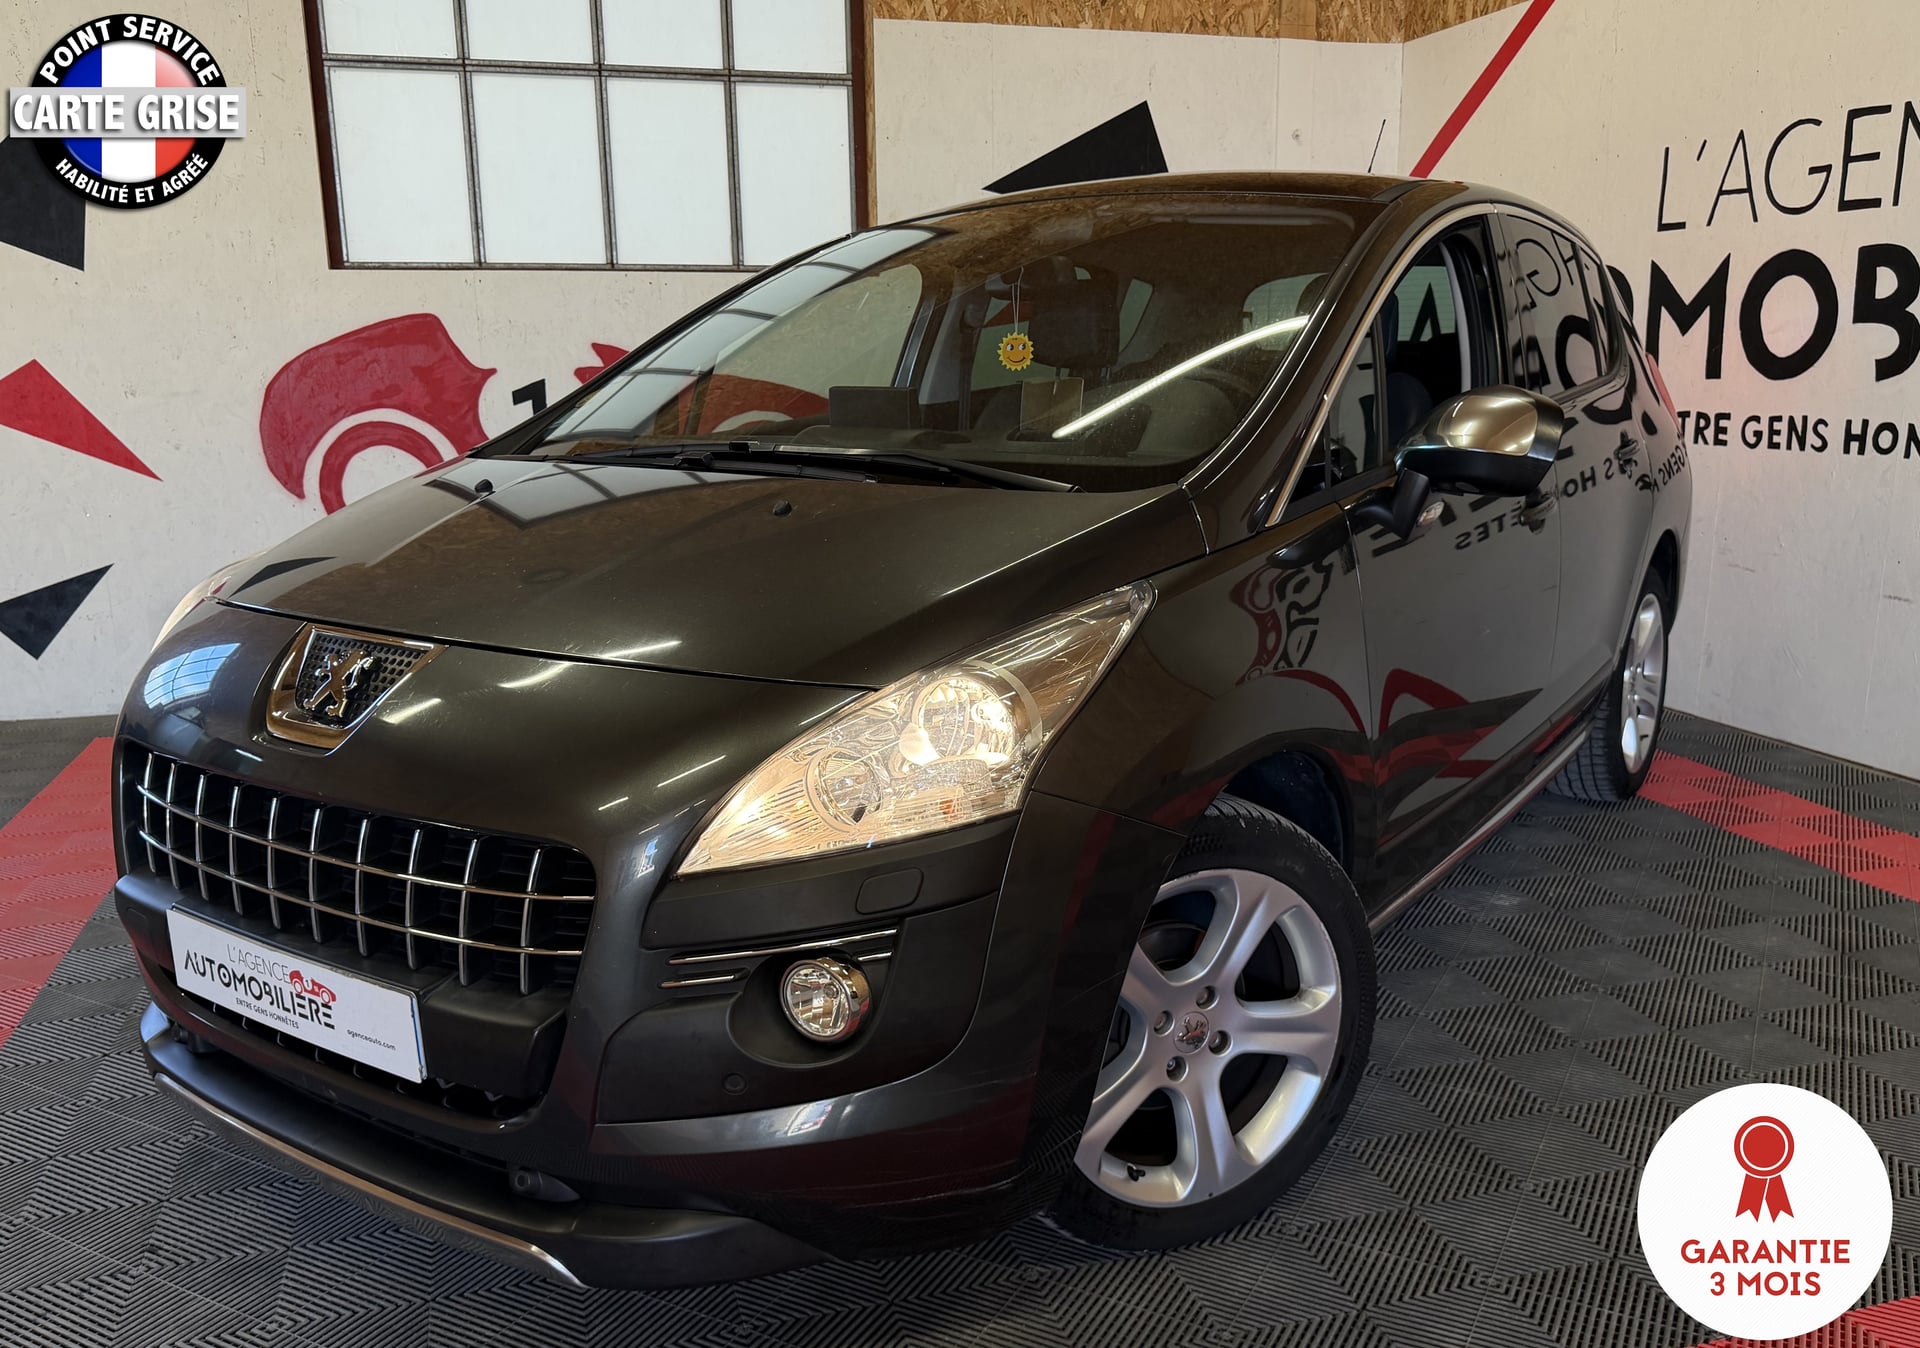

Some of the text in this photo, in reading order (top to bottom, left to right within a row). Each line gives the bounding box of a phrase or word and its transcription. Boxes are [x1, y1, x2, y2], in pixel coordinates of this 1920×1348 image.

[1741, 415, 1829, 453] GENS
[227, 943, 291, 985] L'AGENCE
[236, 997, 253, 1011] ENTRE
[253, 1004, 269, 1018] GENS
